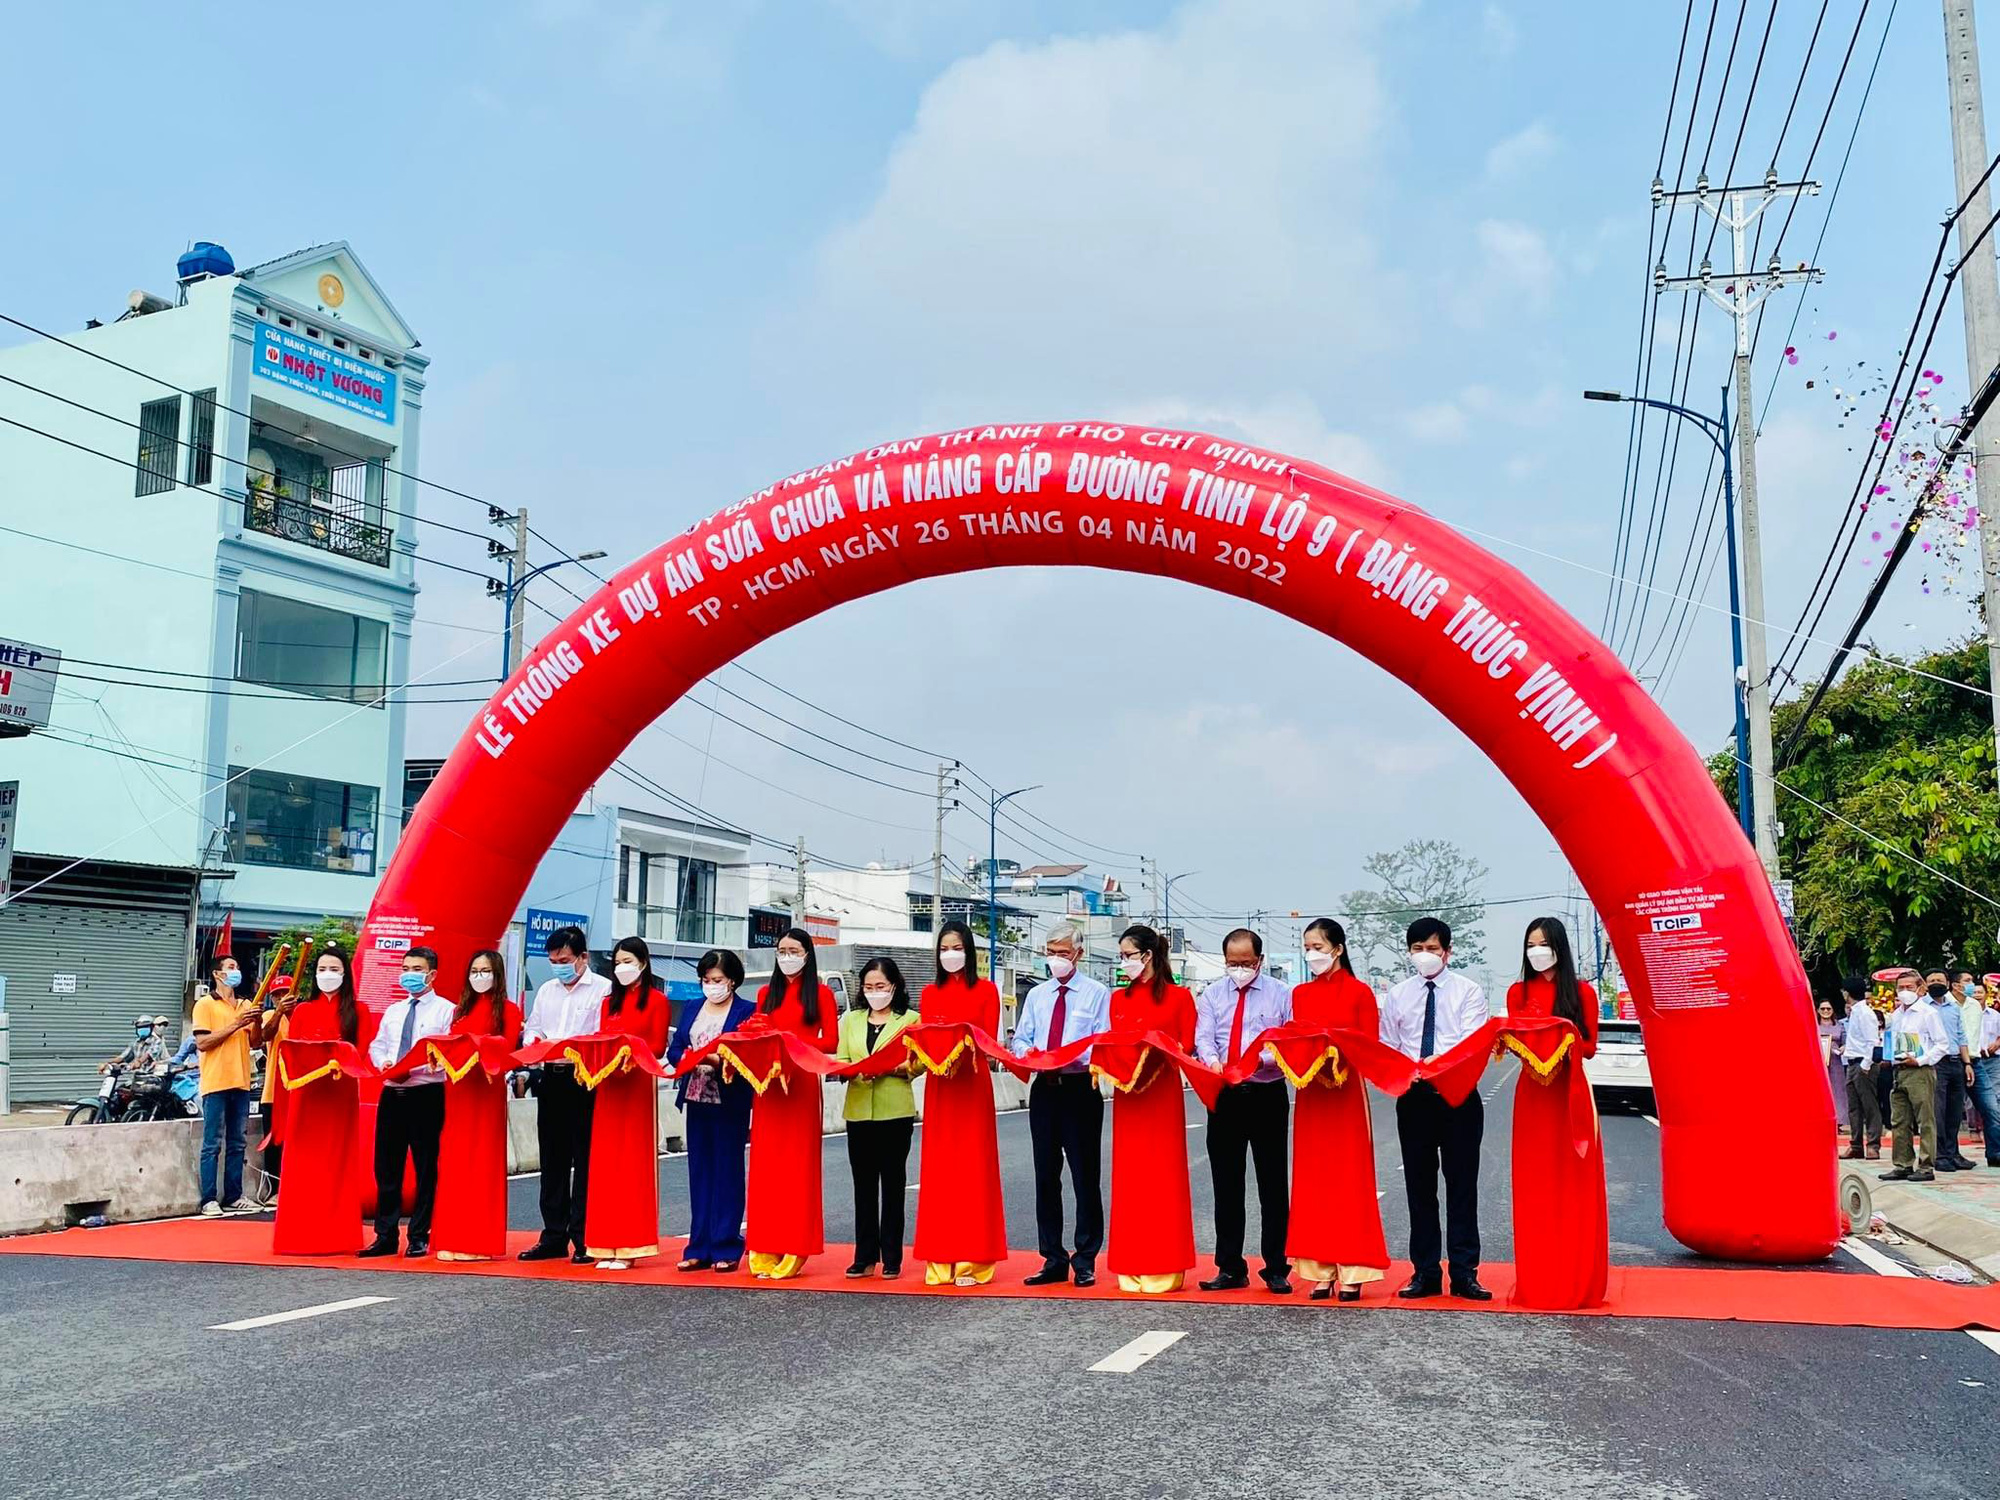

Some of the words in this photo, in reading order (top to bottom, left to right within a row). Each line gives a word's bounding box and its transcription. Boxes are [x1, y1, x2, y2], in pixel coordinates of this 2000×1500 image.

[282, 352, 326, 382] NHẬT
[331, 371, 383, 404] VƯƠNG
[819, 523, 899, 568] NGÀY
[914, 518, 950, 544] 26
[959, 505, 1064, 536] THÁNG
[1078, 515, 1113, 539] 04
[1126, 517, 1196, 554] NĂM
[1214, 540, 1287, 586] 2022
[475, 706, 515, 759] LỄ
[502, 640, 584, 725] THÔNG
[578, 607, 621, 656] XE
[617, 571, 661, 625] DỰ
[664, 548, 704, 598] ÁN
[770, 477, 846, 543] CHỮA
[854, 463, 891, 513] VÀ
[902, 453, 982, 504] NÂNG
[995, 442, 1052, 494] CẤP
[1066, 450, 1170, 505] ĐƯỜNG
[1181, 460, 1257, 527] TỈNH
[1259, 492, 1310, 551] LỘ
[1306, 515, 1338, 557] 9
[1356, 537, 1450, 621] ĐẶNG
[1442, 594, 1529, 679] THÚC
[1514, 661, 1602, 751] VỊNH
[377, 939, 403, 949] TCIP
[1653, 917, 1692, 931] TCIP
